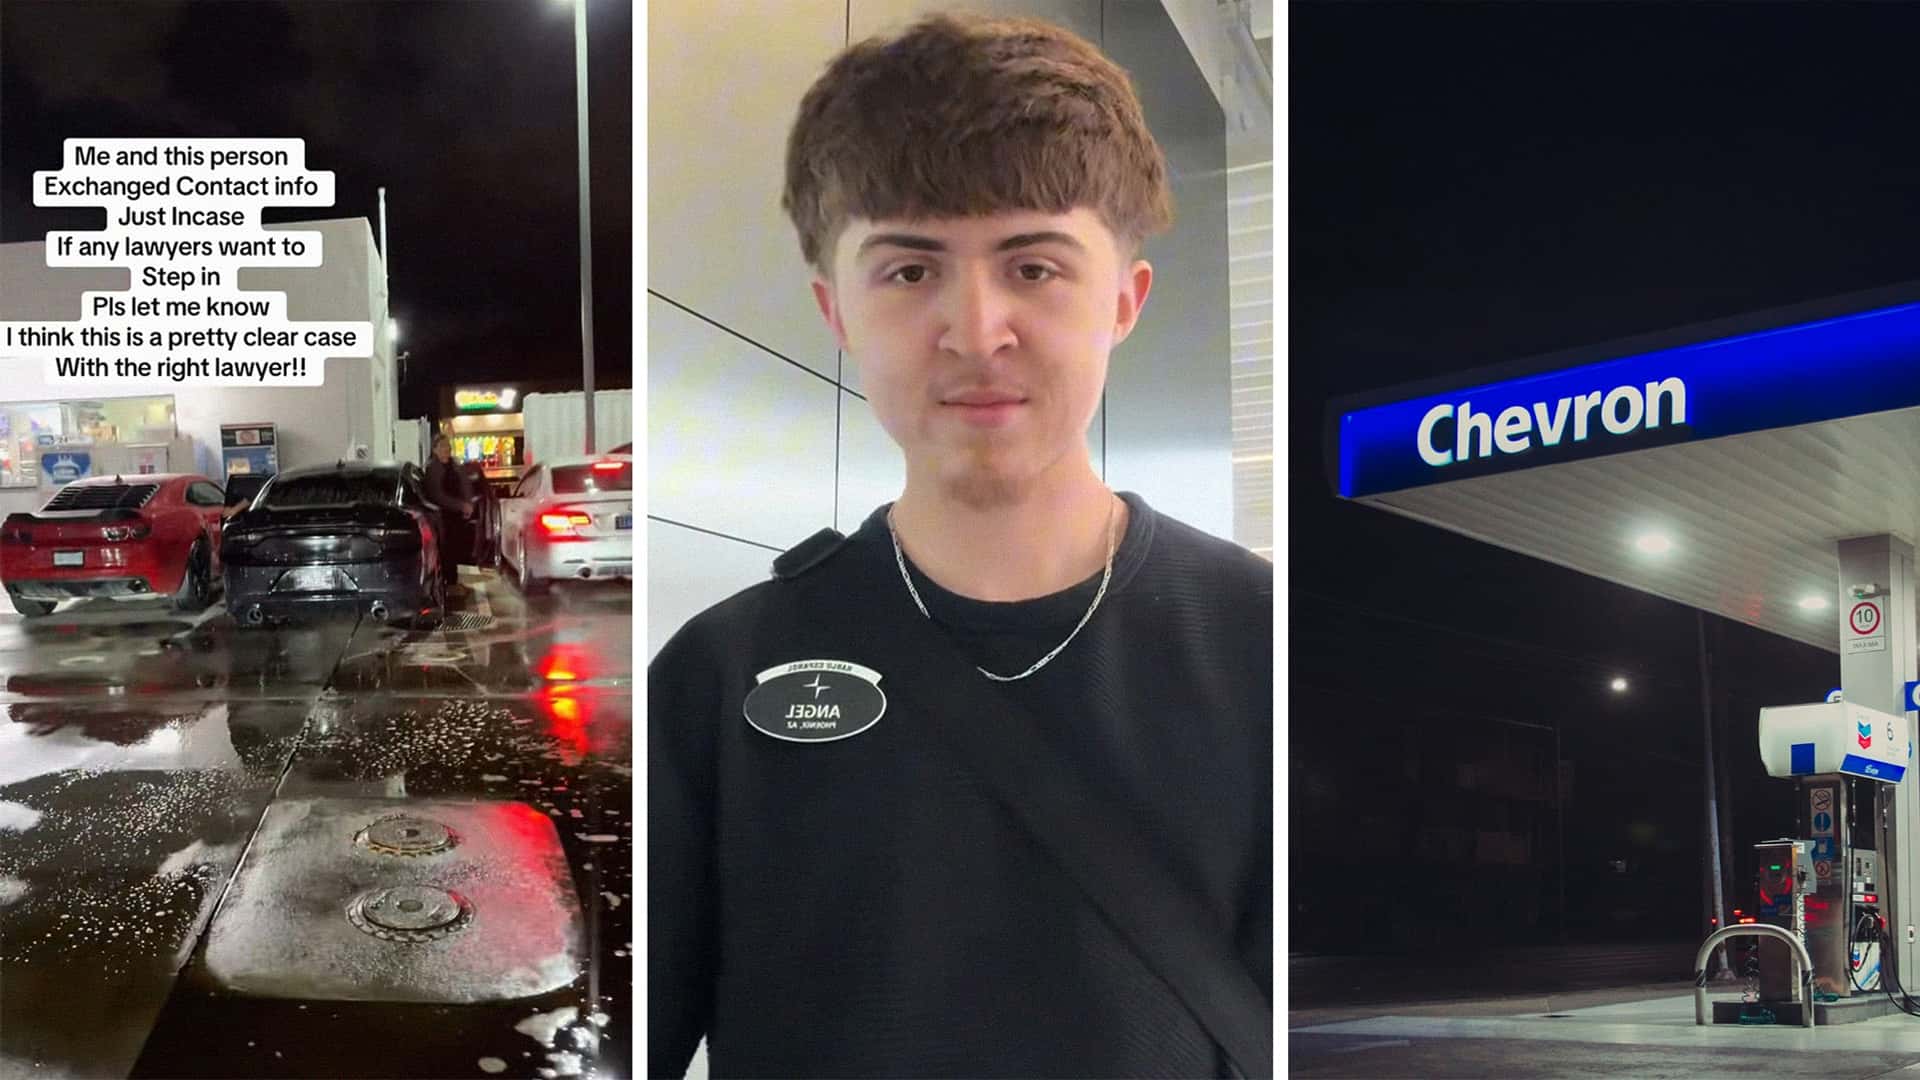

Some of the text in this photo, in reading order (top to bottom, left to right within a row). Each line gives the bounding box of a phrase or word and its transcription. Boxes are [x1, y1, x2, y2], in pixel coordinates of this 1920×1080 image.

[1417, 377, 1686, 466] Chevron
[1856, 608, 1873, 624] 10
[1887, 721, 1895, 741] 6
